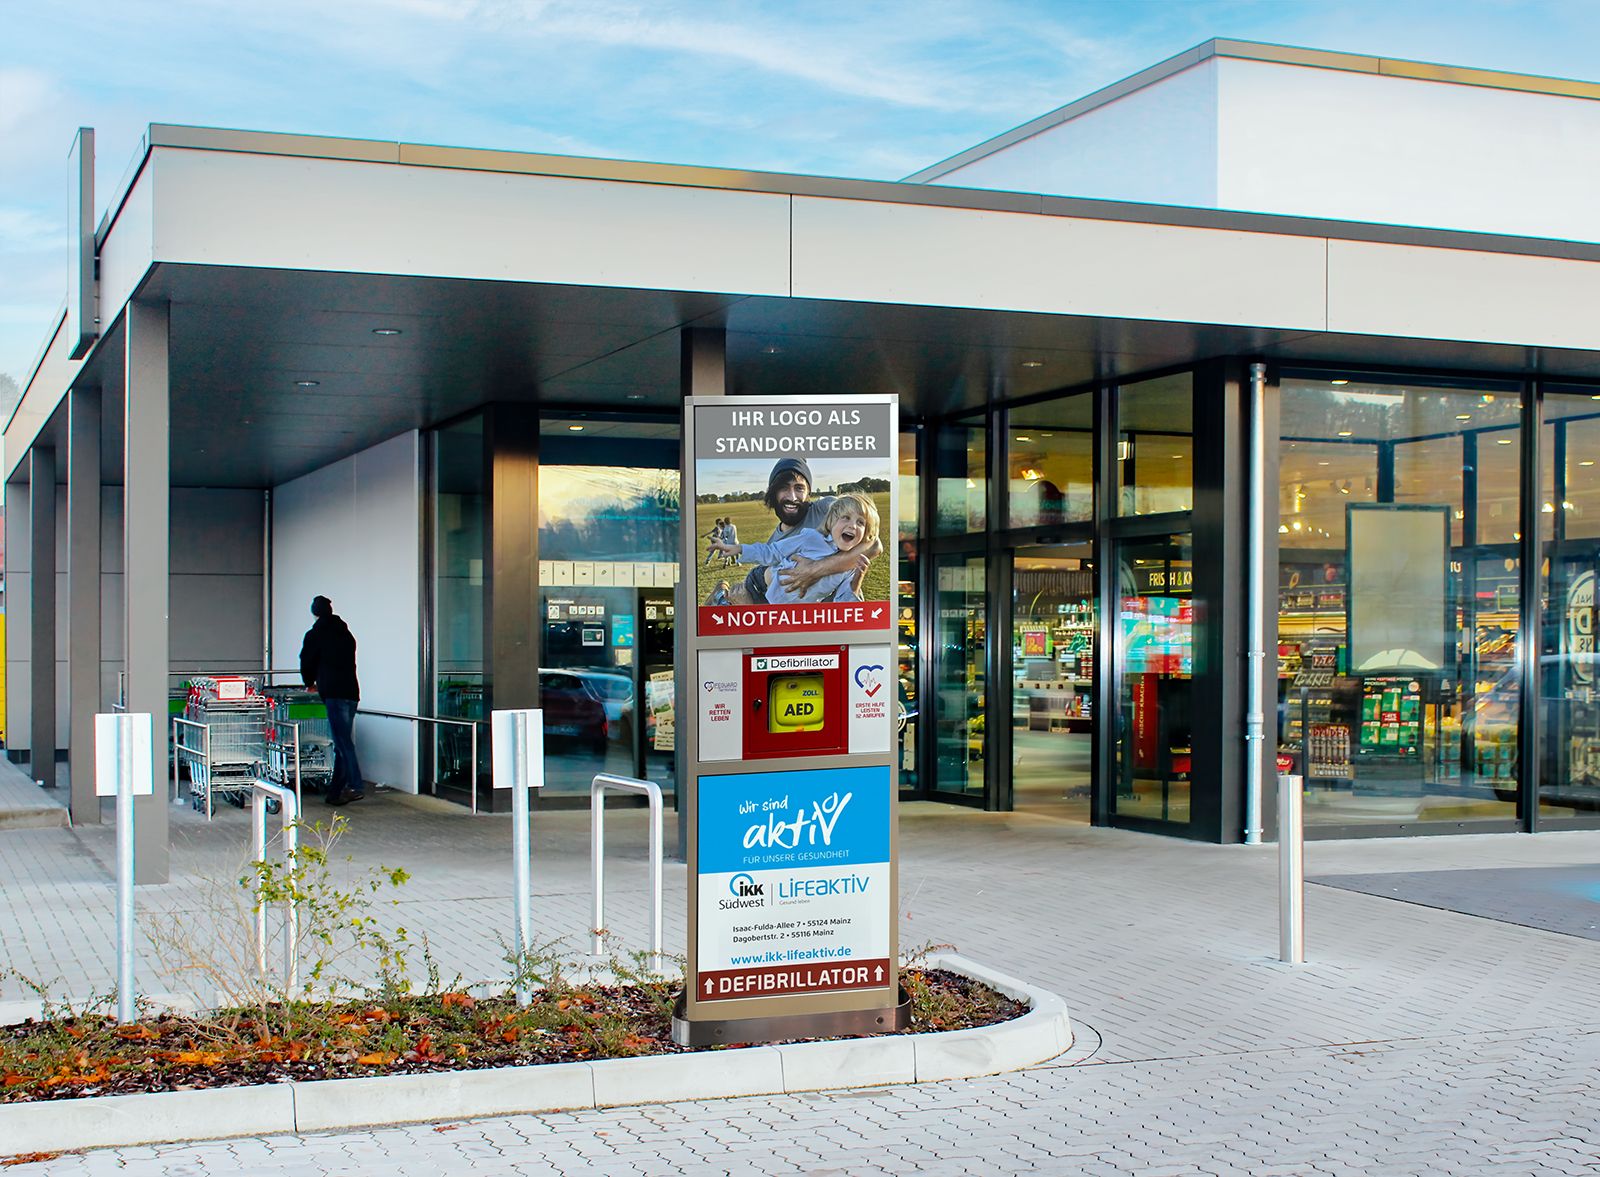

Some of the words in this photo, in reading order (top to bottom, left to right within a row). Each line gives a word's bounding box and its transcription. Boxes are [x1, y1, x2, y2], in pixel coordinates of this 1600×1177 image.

[732, 411, 764, 427] IHR
[771, 410, 823, 426] LOGO
[828, 410, 861, 425] ALS
[716, 435, 877, 453] STANDORTGEBER
[1149, 572, 1176, 587] FRISH
[727, 607, 864, 627] NOTFALLHILFE
[770, 657, 834, 669] Defibrillator
[802, 689, 819, 697] ZOLL
[784, 703, 815, 717] AED
[762, 794, 789, 812] sind
[743, 856, 761, 864] FÜR
[762, 853, 795, 863] UNSERE
[797, 849, 850, 861] GESUNDHEIT
[718, 898, 765, 910] Südwest
[732, 921, 795, 933] Isaac-Fulda-Allee
[807, 919, 829, 927] 55124
[829, 918, 852, 926] Mainz
[732, 933, 779, 944] Dagobertstr.
[791, 931, 811, 939] 55116
[812, 929, 834, 937] Mainz
[731, 946, 852, 965] www.ikk-lifeaktiv.de
[719, 966, 869, 994] DEFIBRILLATOR
